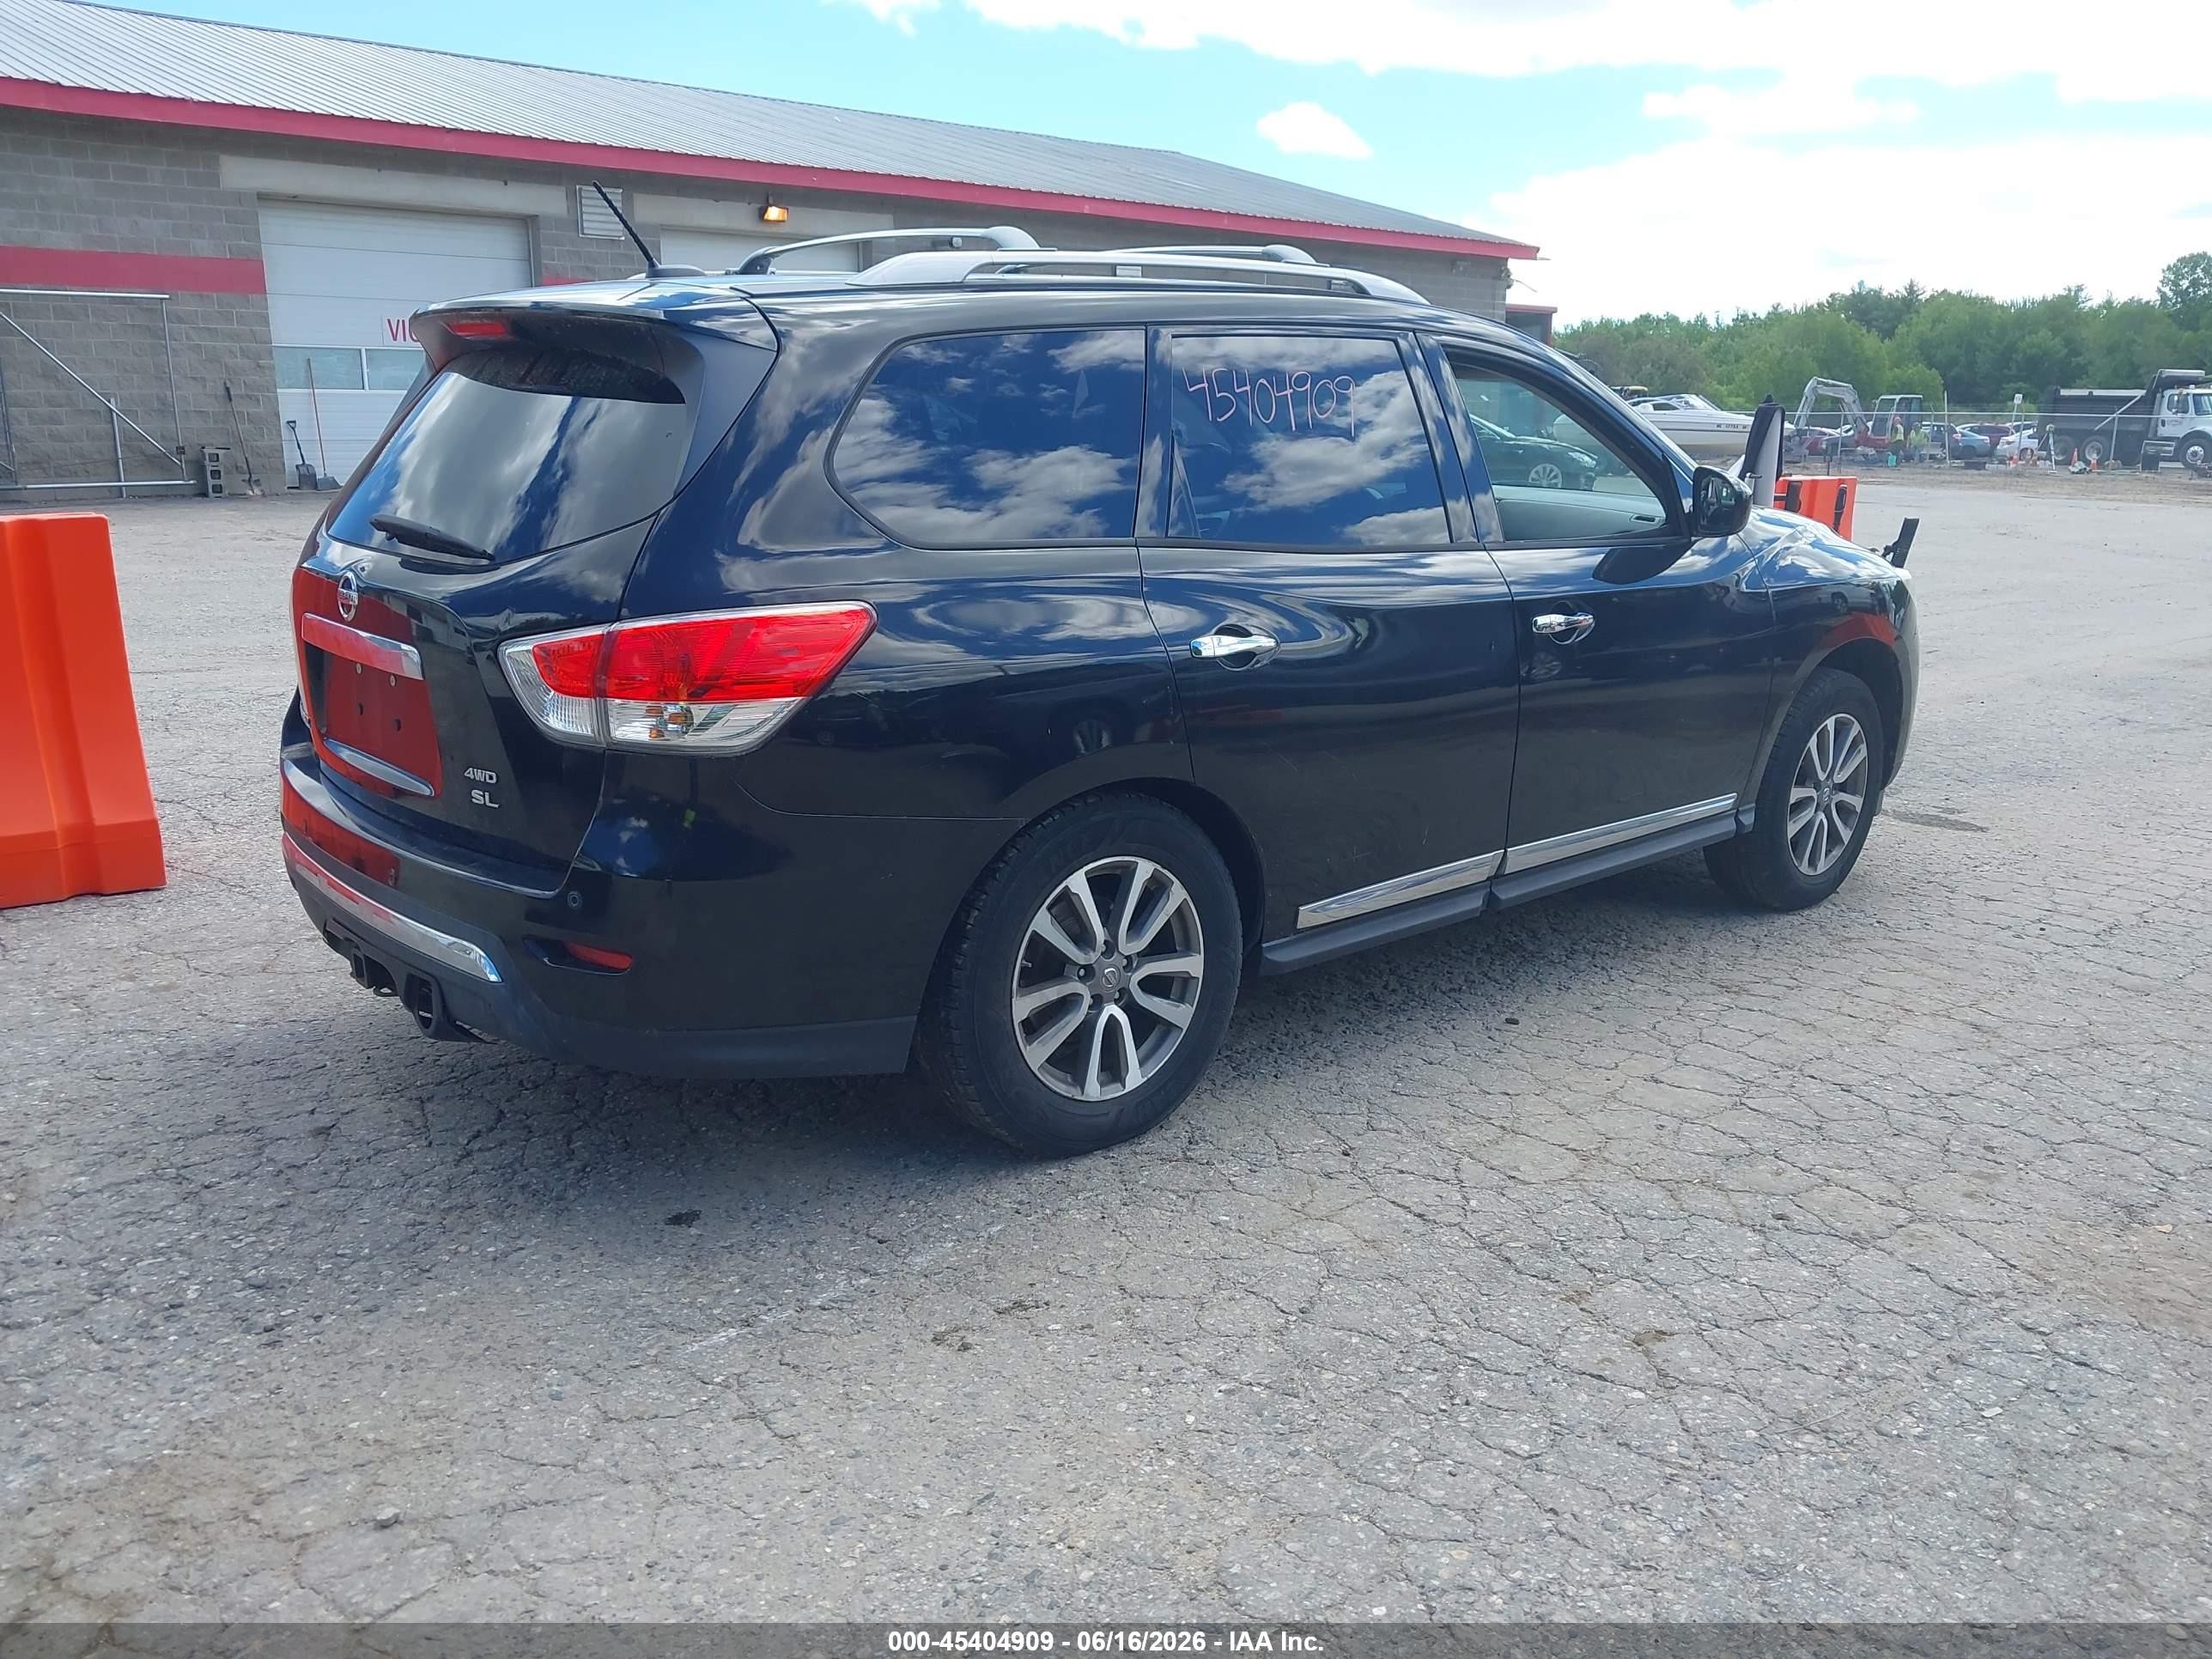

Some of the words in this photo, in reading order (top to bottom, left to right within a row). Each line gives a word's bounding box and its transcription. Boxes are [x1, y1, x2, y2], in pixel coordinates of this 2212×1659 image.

[1182, 366, 1356, 438] 45404909
[464, 767, 497, 784] 4WD
[471, 789, 500, 808] SL
